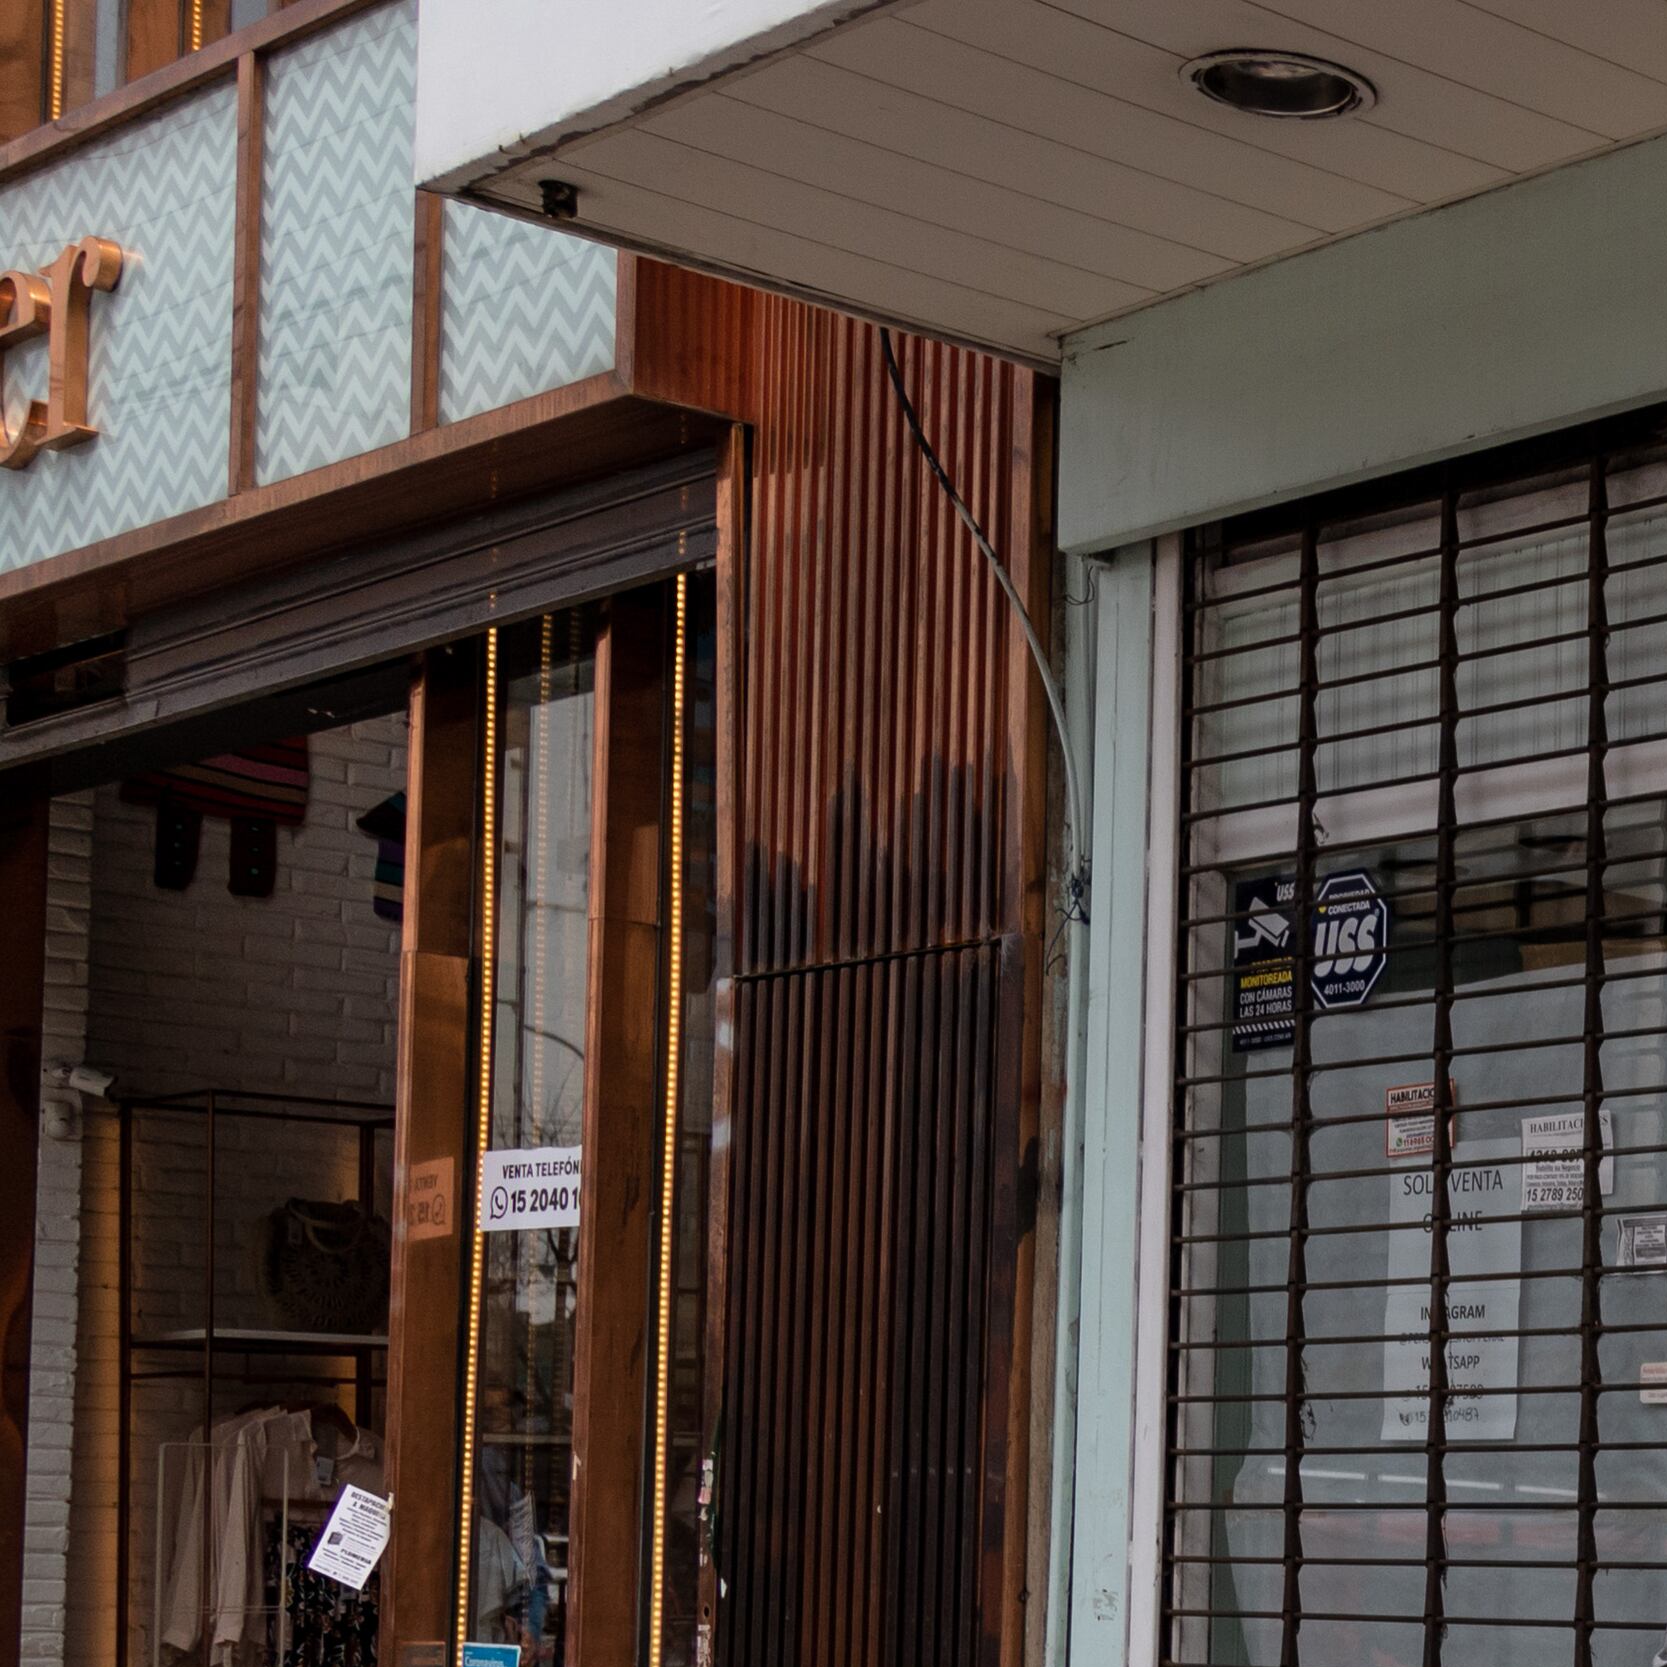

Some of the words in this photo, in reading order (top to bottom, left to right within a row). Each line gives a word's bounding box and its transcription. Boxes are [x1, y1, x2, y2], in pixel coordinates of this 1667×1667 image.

[1327, 900, 1371, 915] CONECTADA
[1240, 970, 1293, 988] MONITOREADA
[1240, 991, 1255, 1004] CON
[1256, 986, 1292, 1001] CÁMARAS
[1324, 980, 1366, 996] 4011-3000
[1239, 1005, 1254, 1018] LAS
[1255, 1002, 1265, 1016] 24
[1266, 1000, 1292, 1015] HORAS
[503, 1162, 534, 1179] VENTA
[1403, 1174, 1432, 1196] SOL
[1451, 1169, 1503, 1192] VENTA
[511, 1190, 526, 1214] 15
[530, 1187, 569, 1213] 2040
[1527, 1188, 1538, 1202] 15
[1540, 1187, 1564, 1201] 2789
[1566, 1187, 1584, 1200] 250
[1421, 1354, 1480, 1370] WTSAPP
